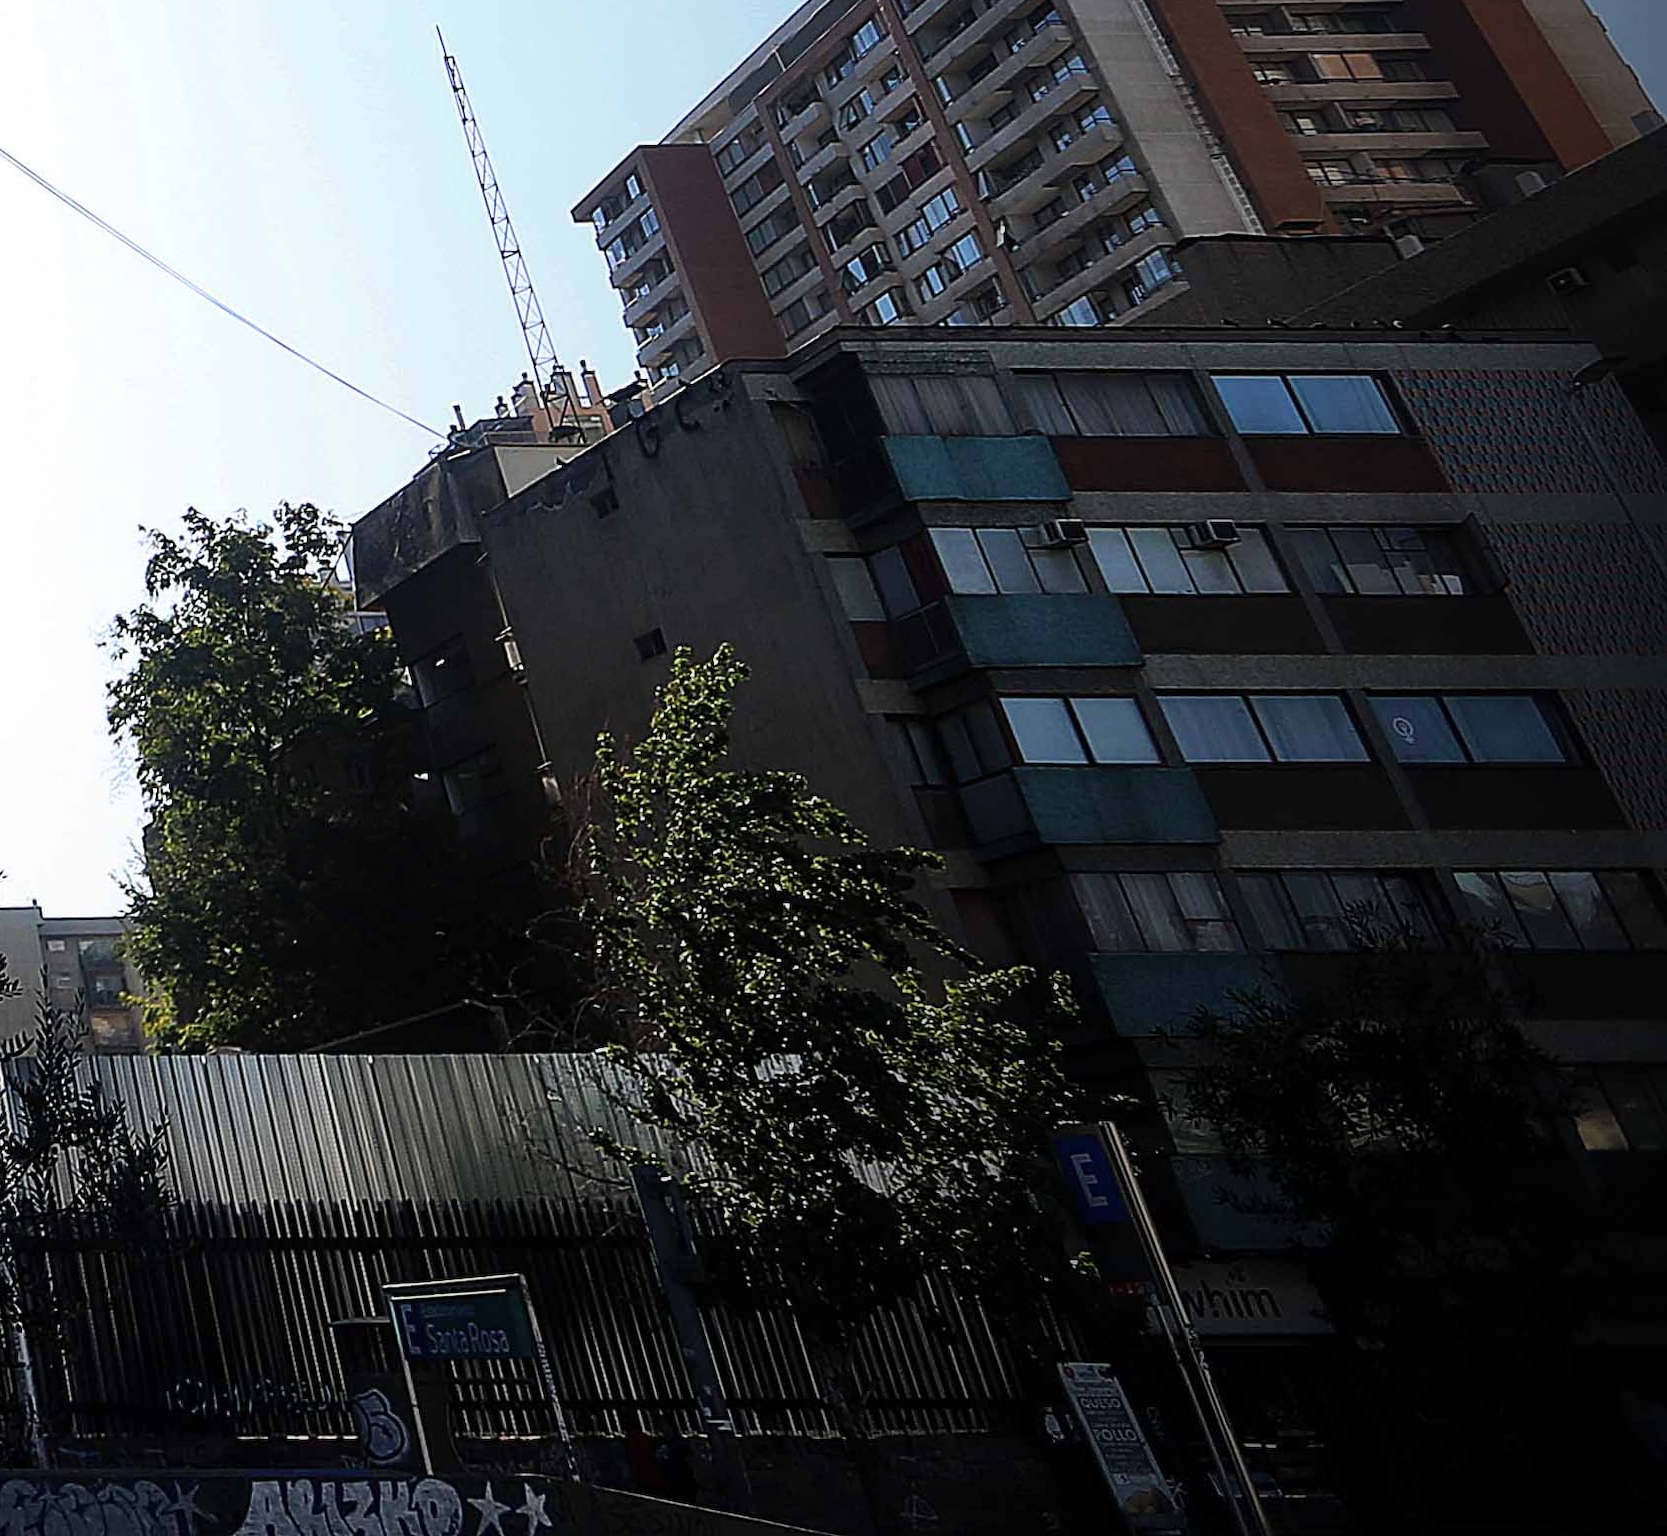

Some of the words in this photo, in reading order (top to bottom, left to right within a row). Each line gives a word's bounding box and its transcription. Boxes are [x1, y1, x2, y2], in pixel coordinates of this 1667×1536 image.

[1070, 1153, 1109, 1207] E
[468, 1321, 510, 1352] Rosa
[1079, 1397, 1121, 1409] QUESO
[1093, 1428, 1137, 1441] POLLO
